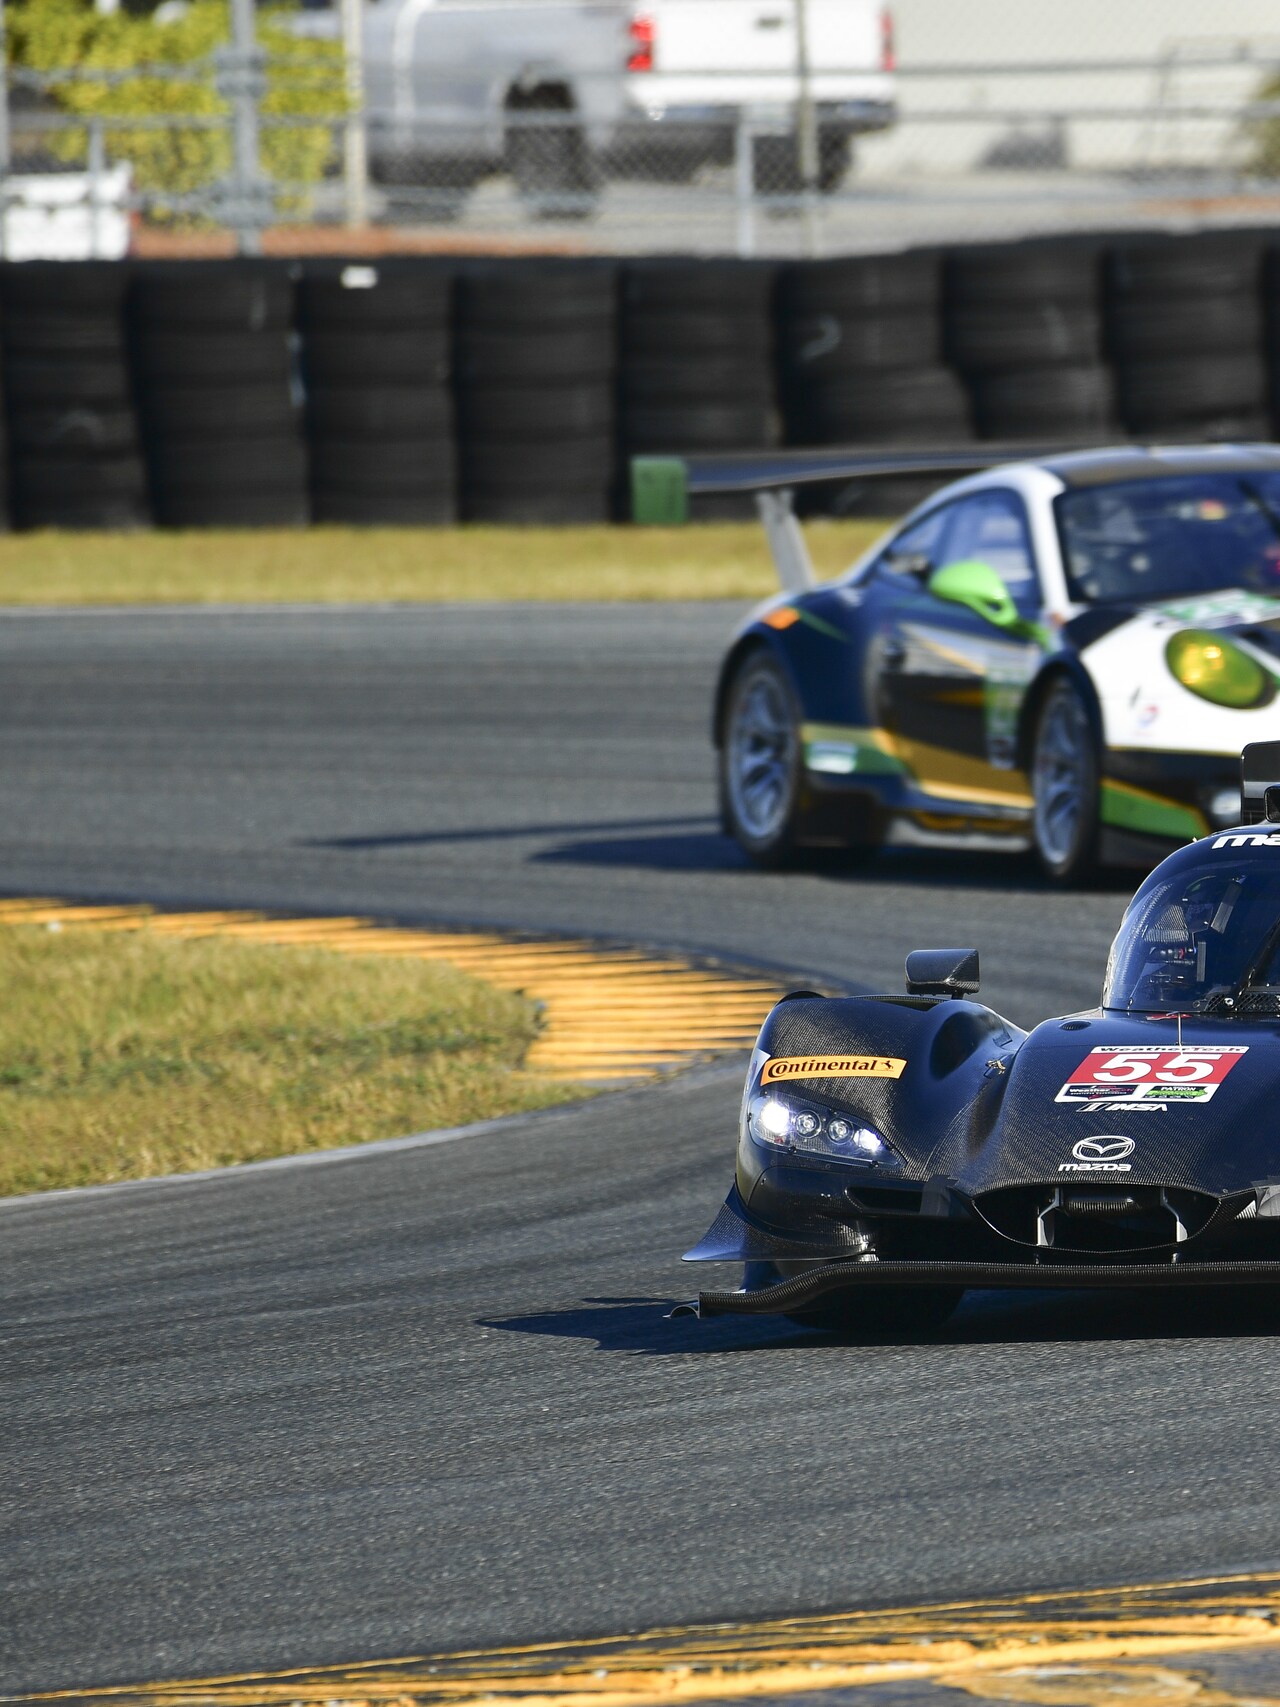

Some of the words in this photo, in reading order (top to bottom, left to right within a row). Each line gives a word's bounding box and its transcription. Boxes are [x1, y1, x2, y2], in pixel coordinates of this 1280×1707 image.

[767, 1059, 877, 1078] Continental
[1093, 1053, 1223, 1082] 55
[1104, 1103, 1168, 1112] IMSA
[1058, 1163, 1132, 1172] mazda
